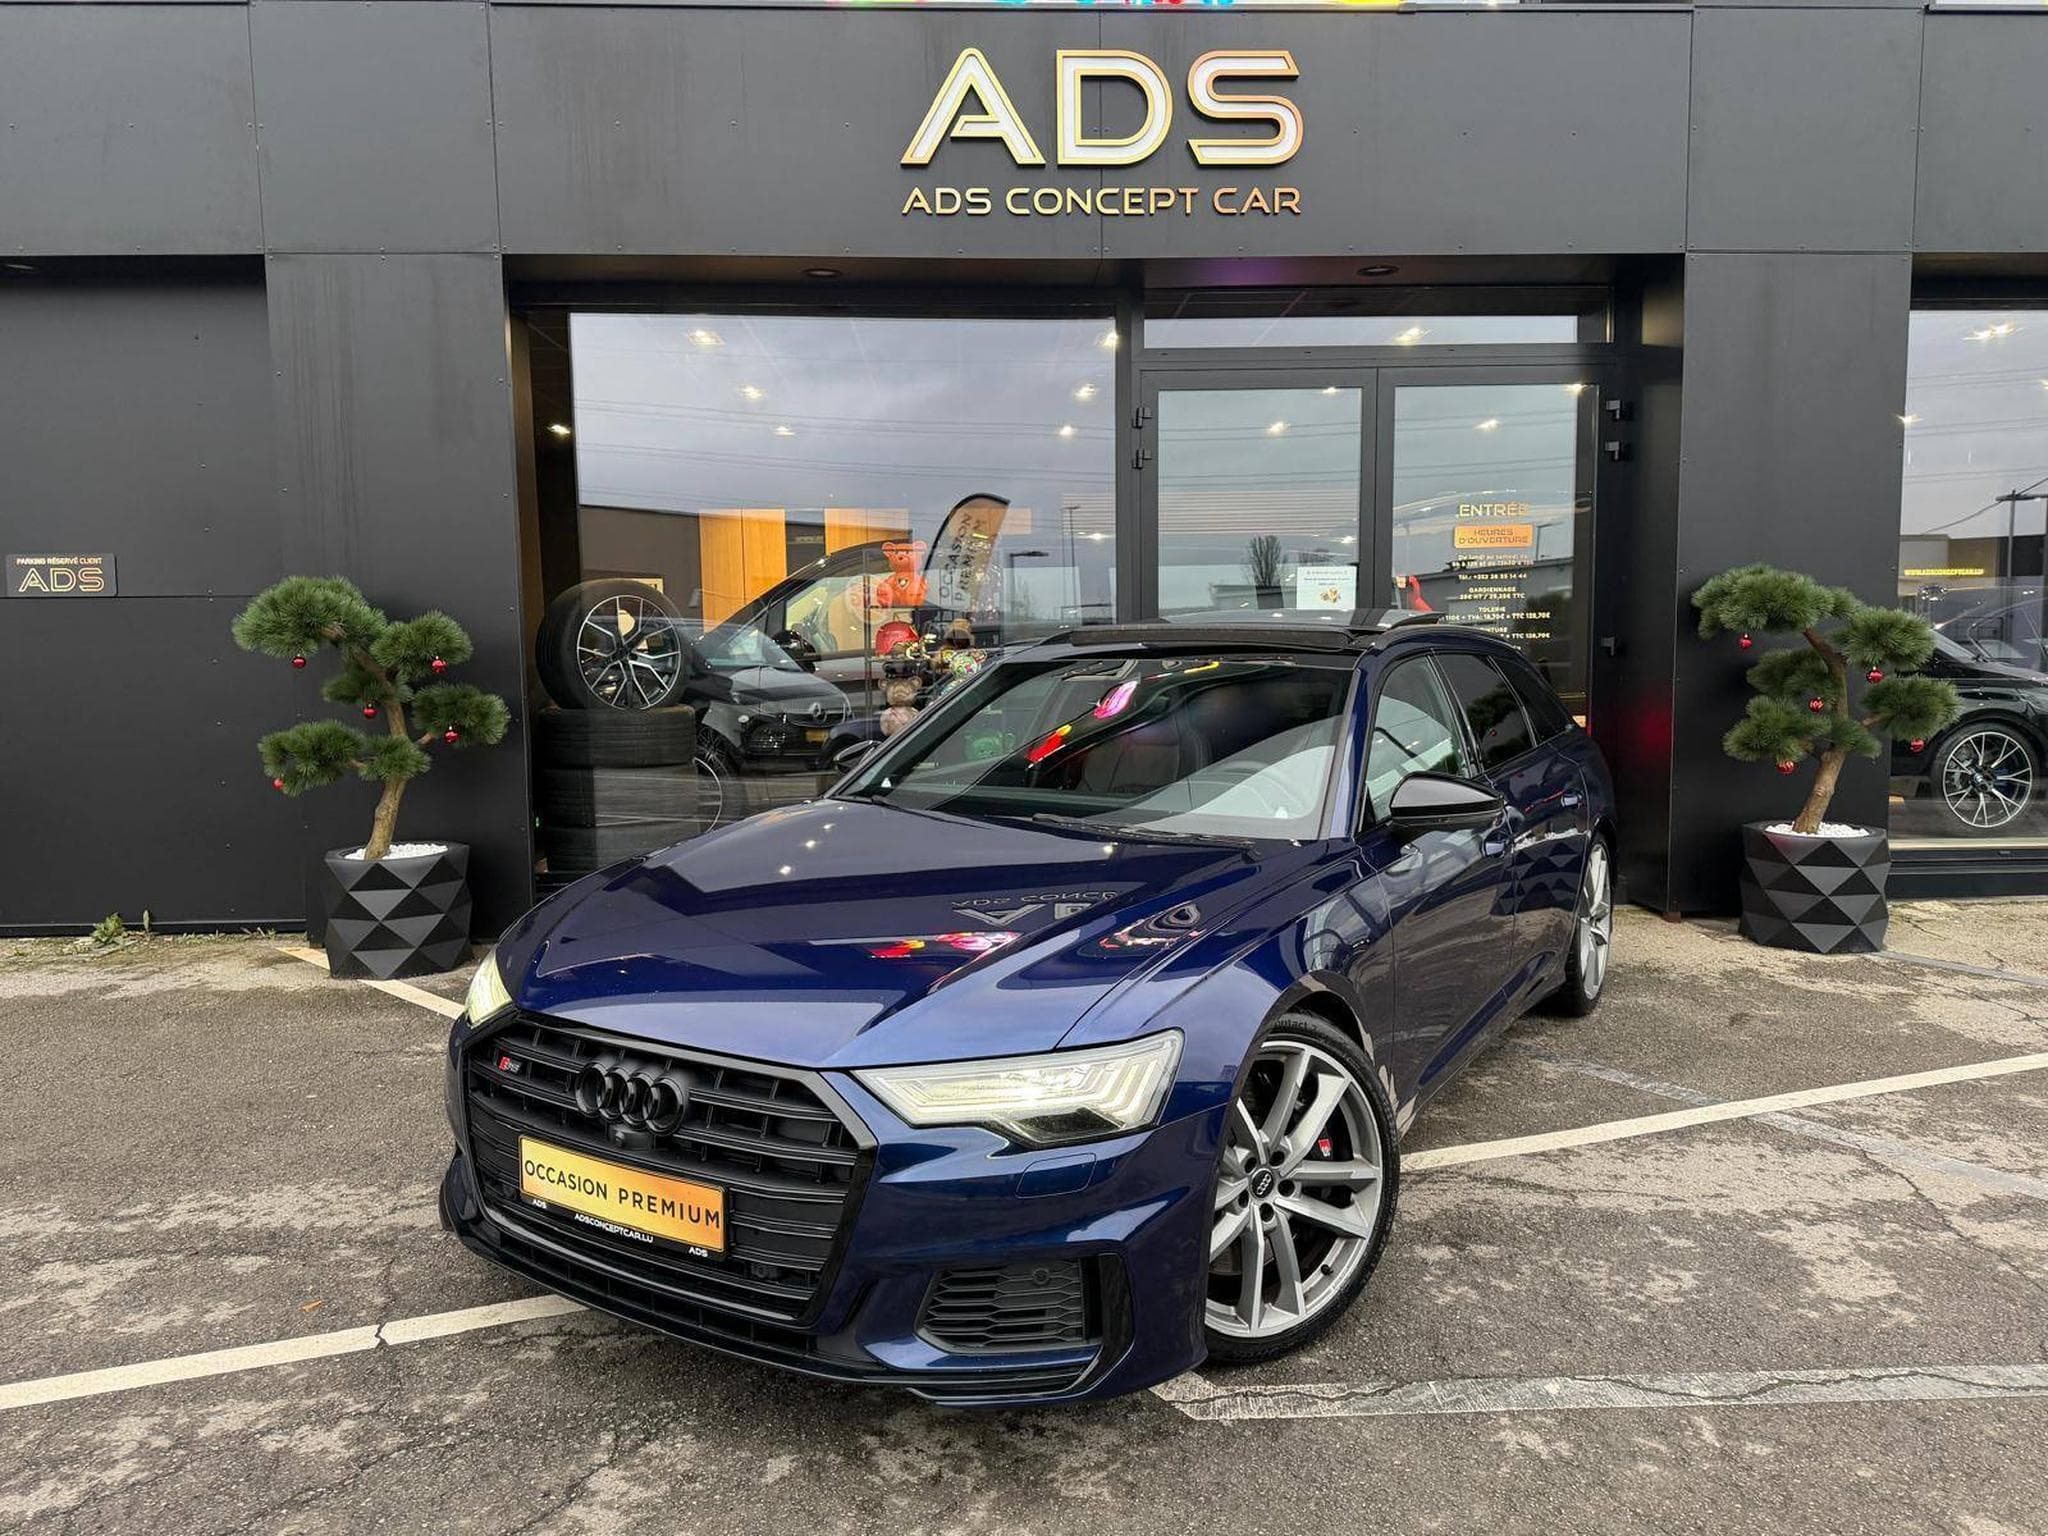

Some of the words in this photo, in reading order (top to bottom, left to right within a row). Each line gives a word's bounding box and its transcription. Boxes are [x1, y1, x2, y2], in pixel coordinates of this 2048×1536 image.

[900, 47, 1305, 166] ADS
[901, 186, 992, 215] ADS
[1005, 186, 1199, 215] CONCEPT
[1212, 186, 1303, 215] CAR
[1473, 528, 1514, 537] HEURES
[18, 567, 104, 592] ADS
[523, 1159, 608, 1201] OCCASION
[618, 1187, 721, 1230] PREMIUM
[532, 1199, 548, 1210] ADS
[573, 1212, 654, 1244] ADSCONCEPTCAR.LU
[688, 1246, 709, 1259] ADS
